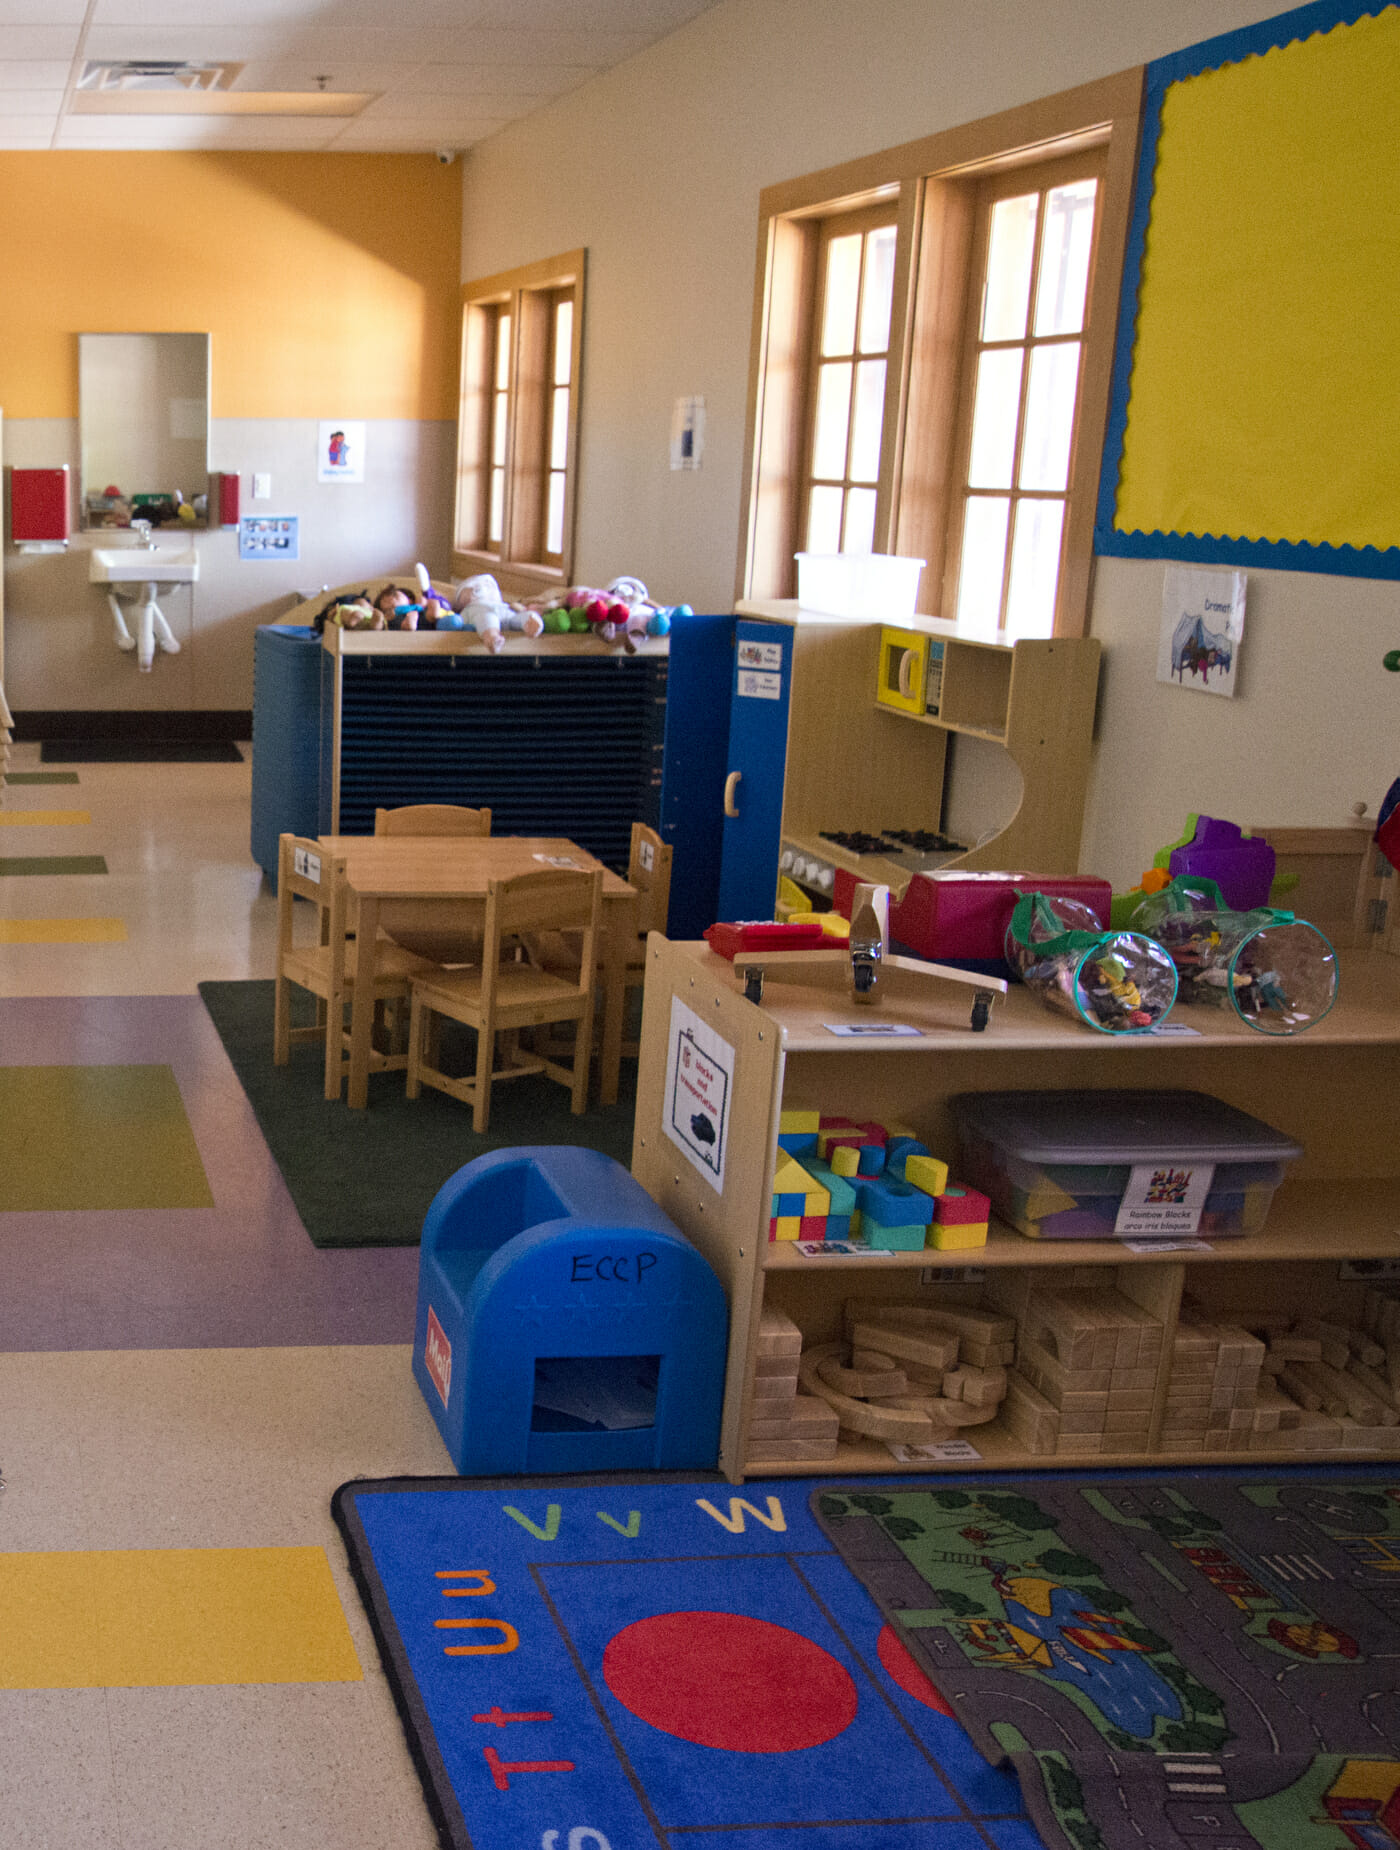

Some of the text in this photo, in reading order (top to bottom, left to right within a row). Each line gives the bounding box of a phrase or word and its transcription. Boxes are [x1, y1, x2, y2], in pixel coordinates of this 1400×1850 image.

[1204, 598, 1234, 613] Dramat
[1129, 1210, 1192, 1219] Rainbow Blocks
[571, 1252, 658, 1284] ECCP
[696, 1497, 787, 1533] W
